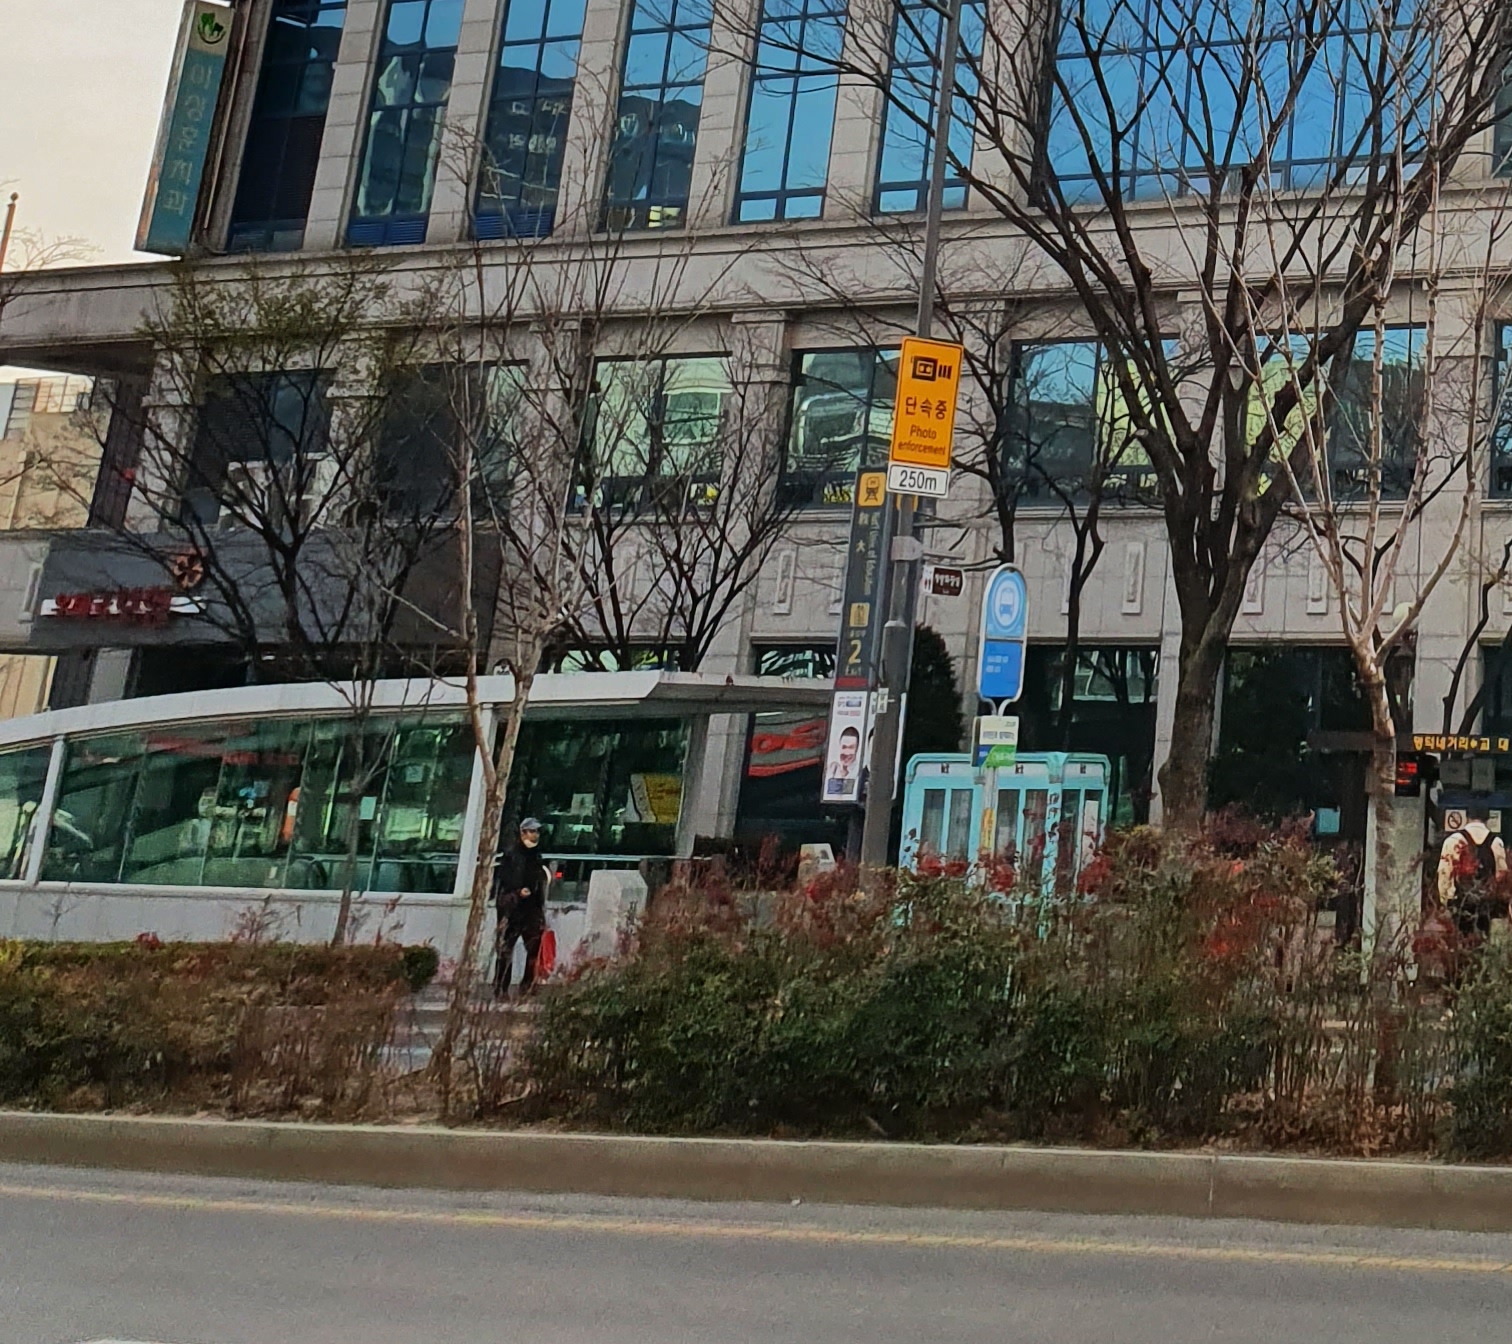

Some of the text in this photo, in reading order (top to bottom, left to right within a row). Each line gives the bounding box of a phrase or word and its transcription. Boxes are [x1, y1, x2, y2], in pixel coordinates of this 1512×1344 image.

[905, 395, 947, 420] 단속중
[910, 424, 937, 440] Photo
[898, 440, 946, 456] enforcement
[899, 470, 937, 490] 250m
[848, 639, 862, 664] 2
[1413, 735, 1468, 751] 명덕네거리
